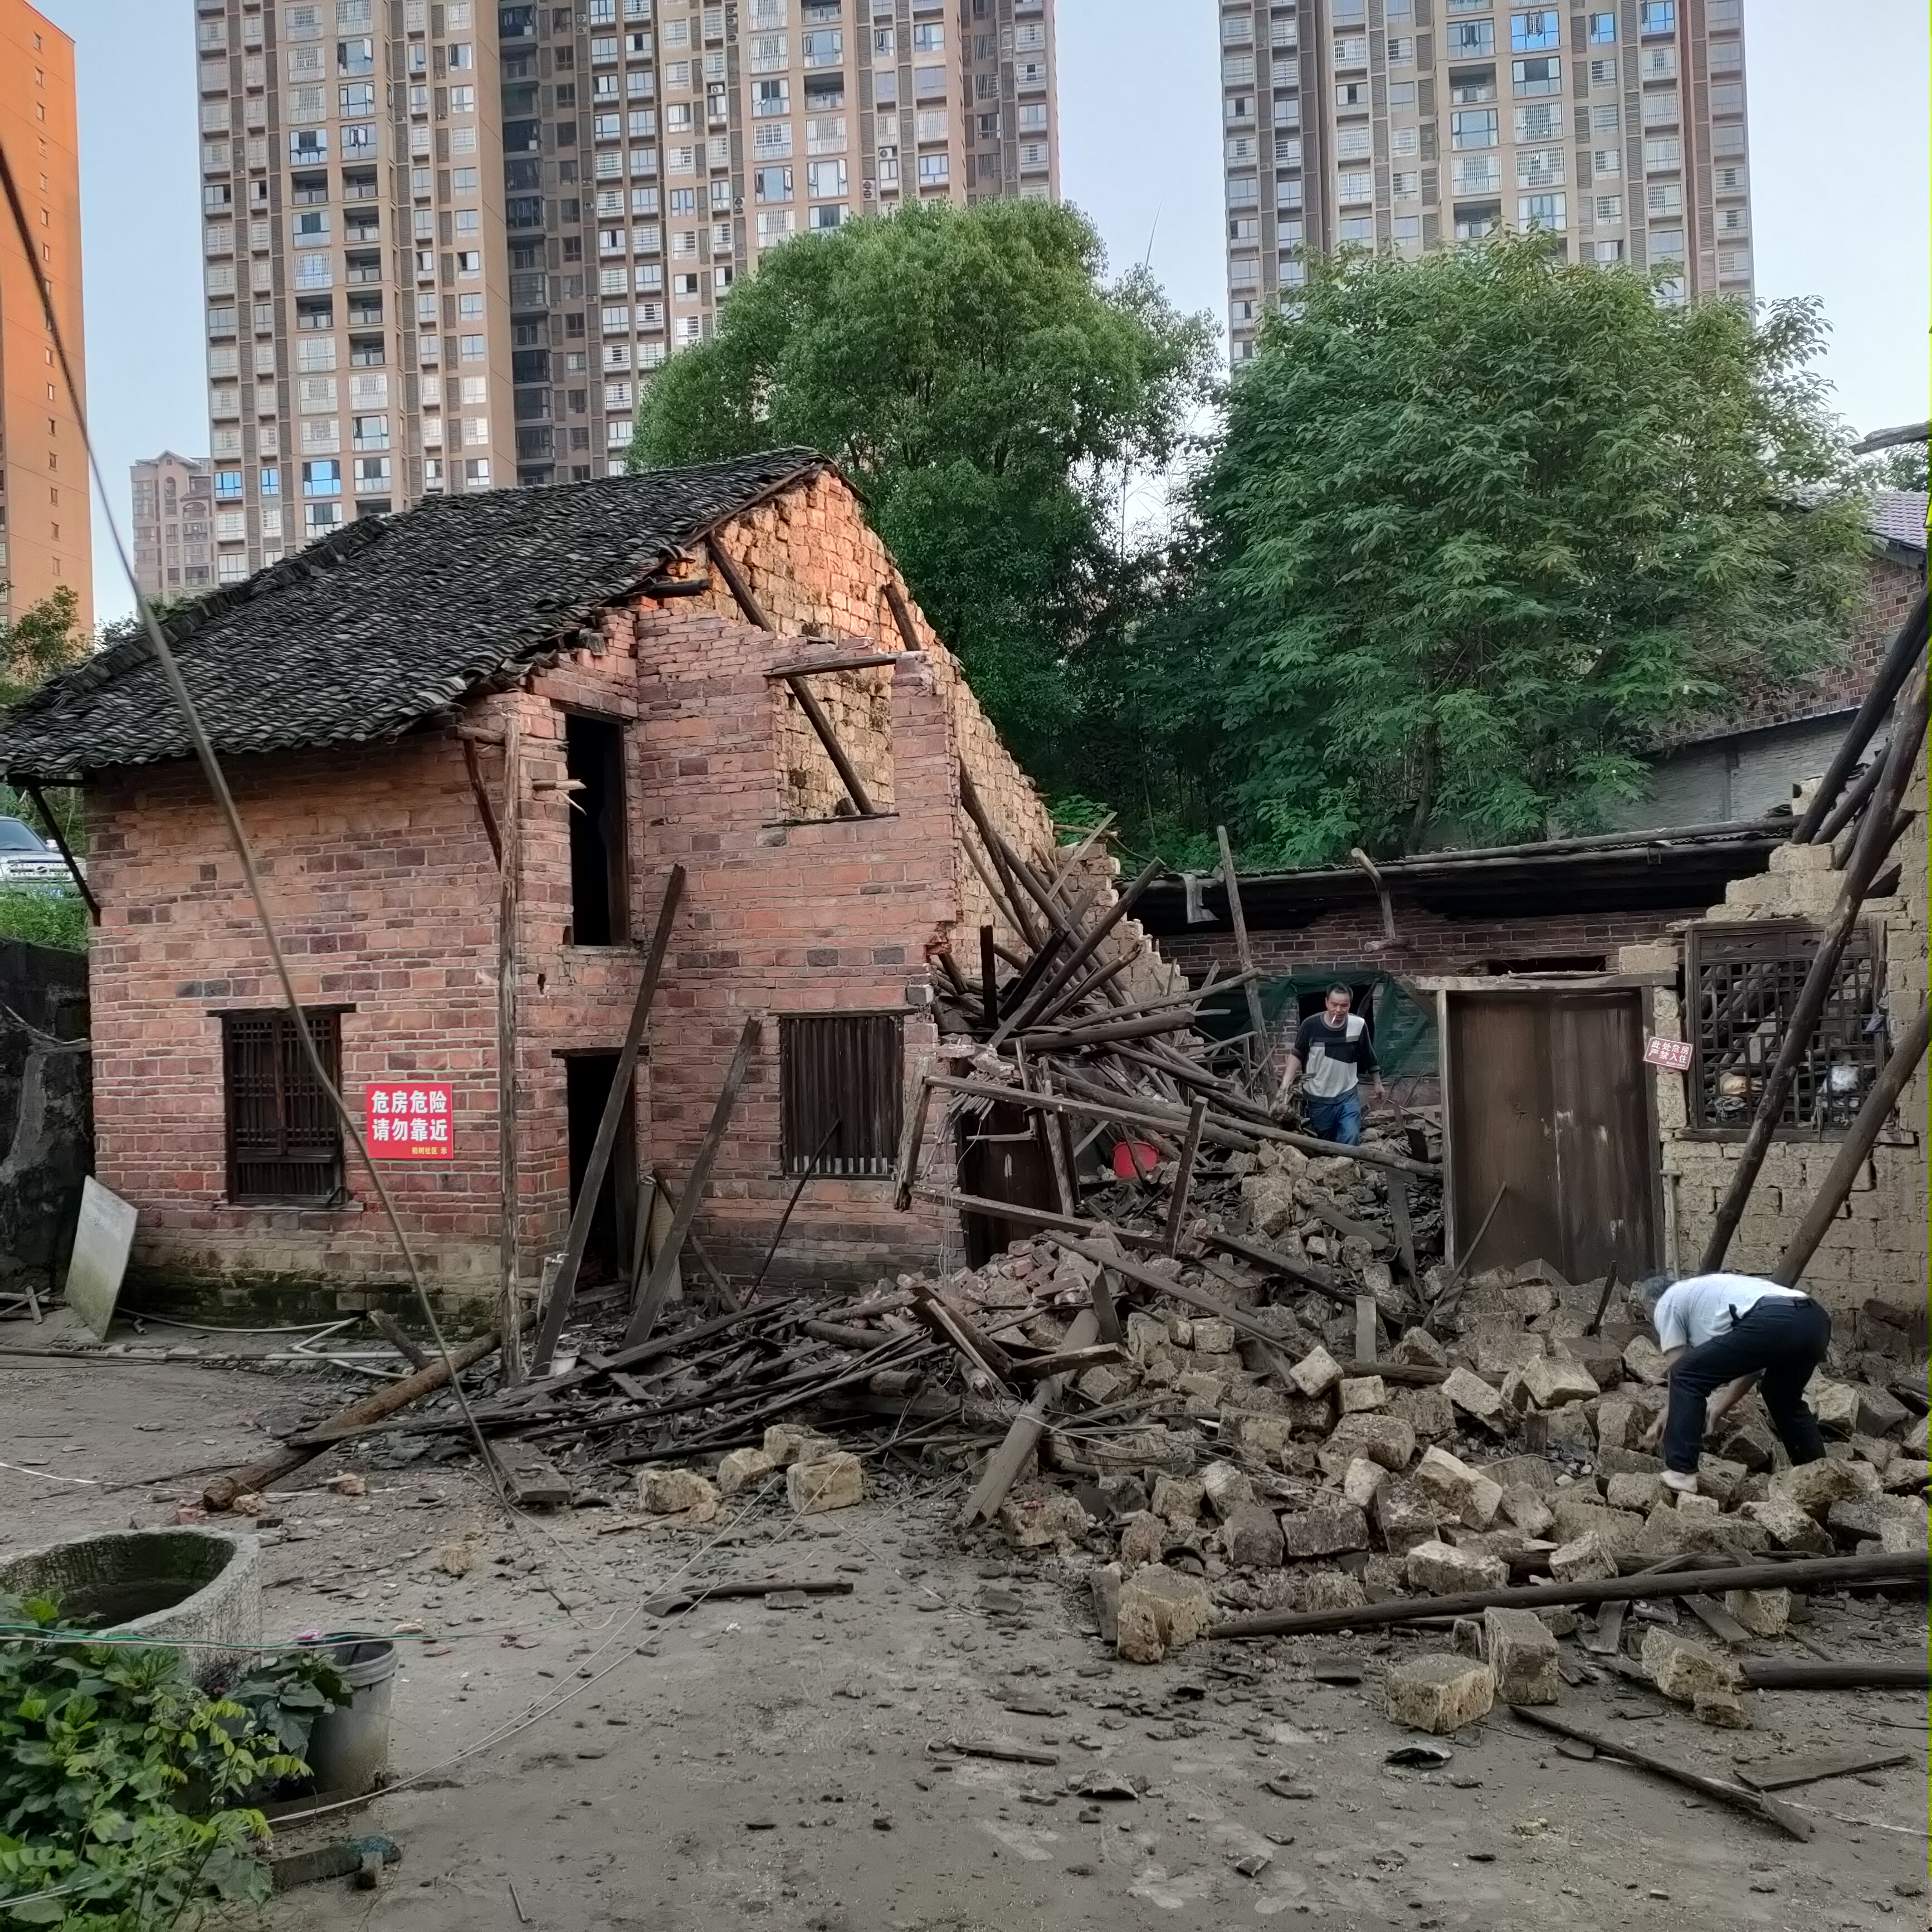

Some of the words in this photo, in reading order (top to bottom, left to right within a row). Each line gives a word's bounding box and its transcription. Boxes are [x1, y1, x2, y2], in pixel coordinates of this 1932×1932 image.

[1648, 1048, 1687, 1063] 严禁入住
[1651, 1040, 1689, 1054] 此处危房
[371, 1090, 447, 1114] 危房危险
[371, 1118, 448, 1141] 请勿靠近
